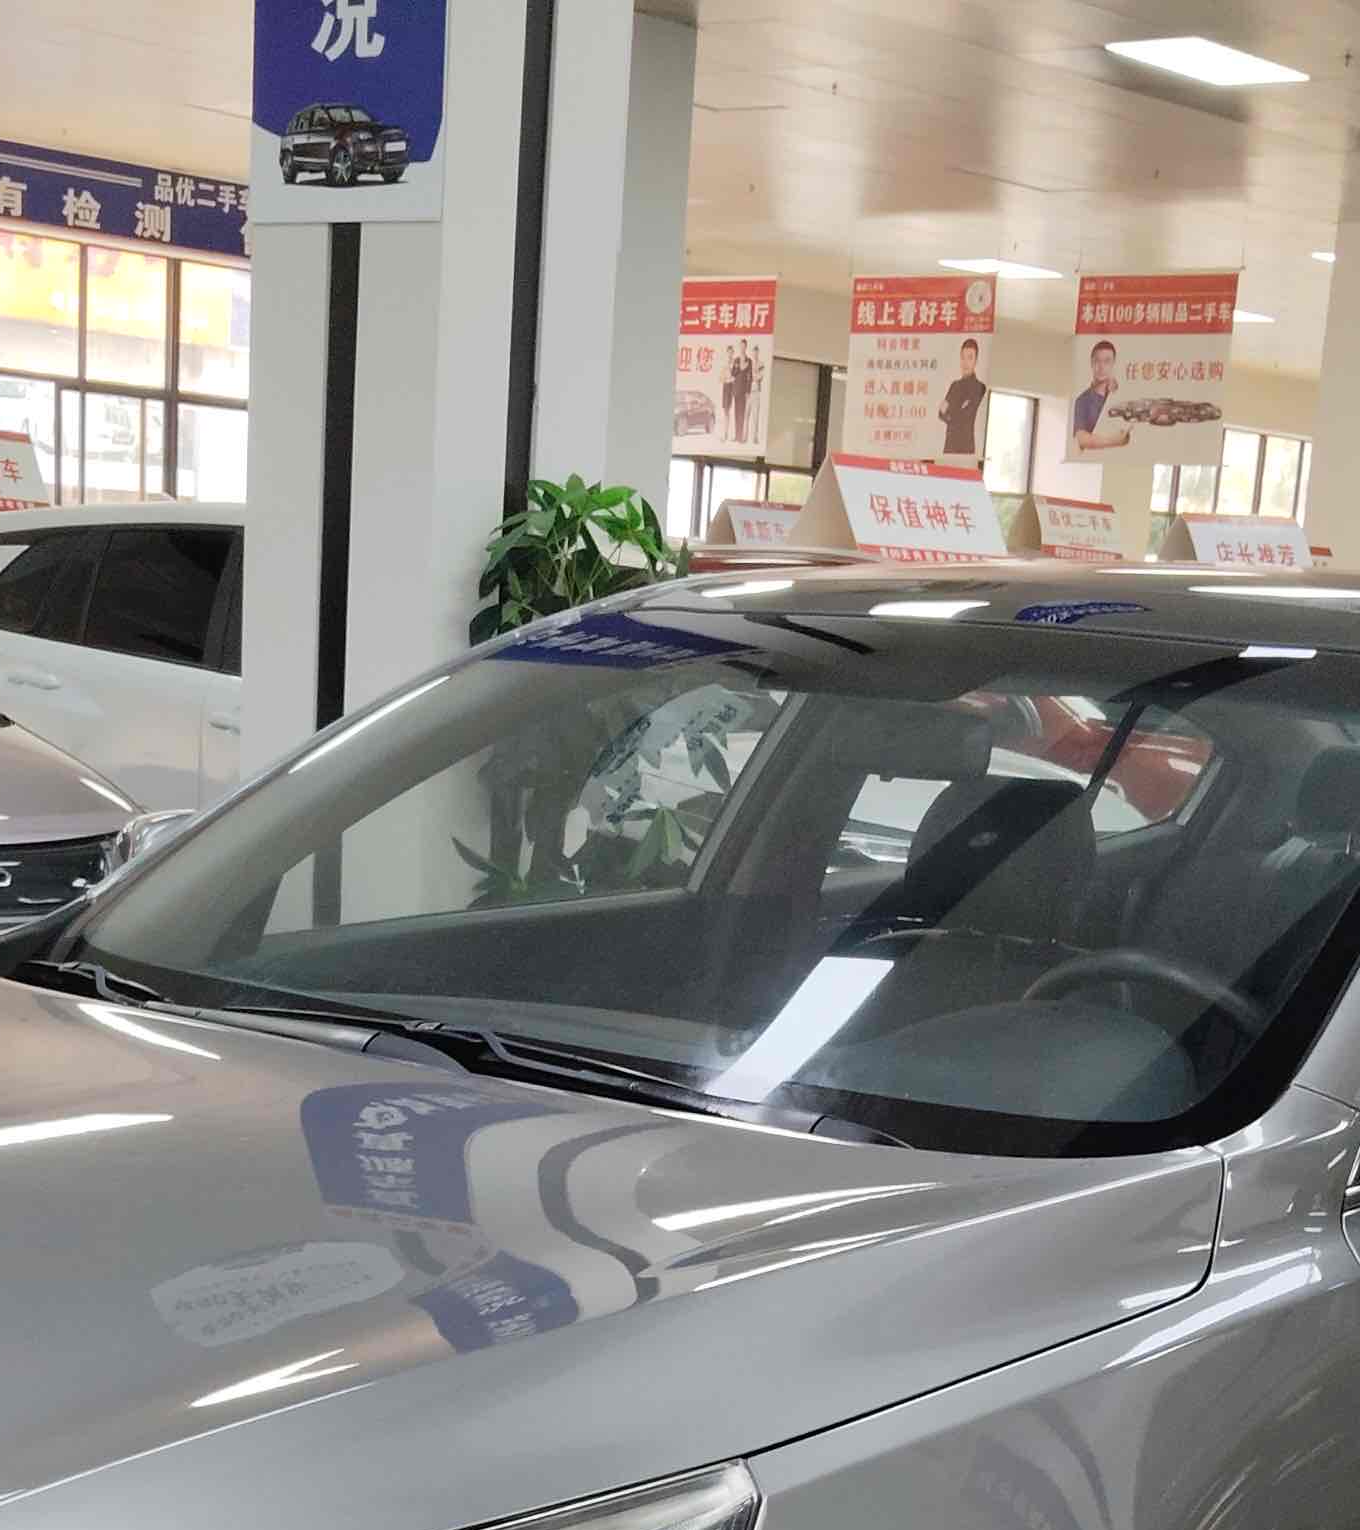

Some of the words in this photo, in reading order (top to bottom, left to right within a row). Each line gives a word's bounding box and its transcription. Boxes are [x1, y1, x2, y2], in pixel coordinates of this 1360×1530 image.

[680, 302, 769, 329] 二手车展厅
[856, 299, 960, 327] 线上看好车
[868, 493, 977, 534] 保值神车
